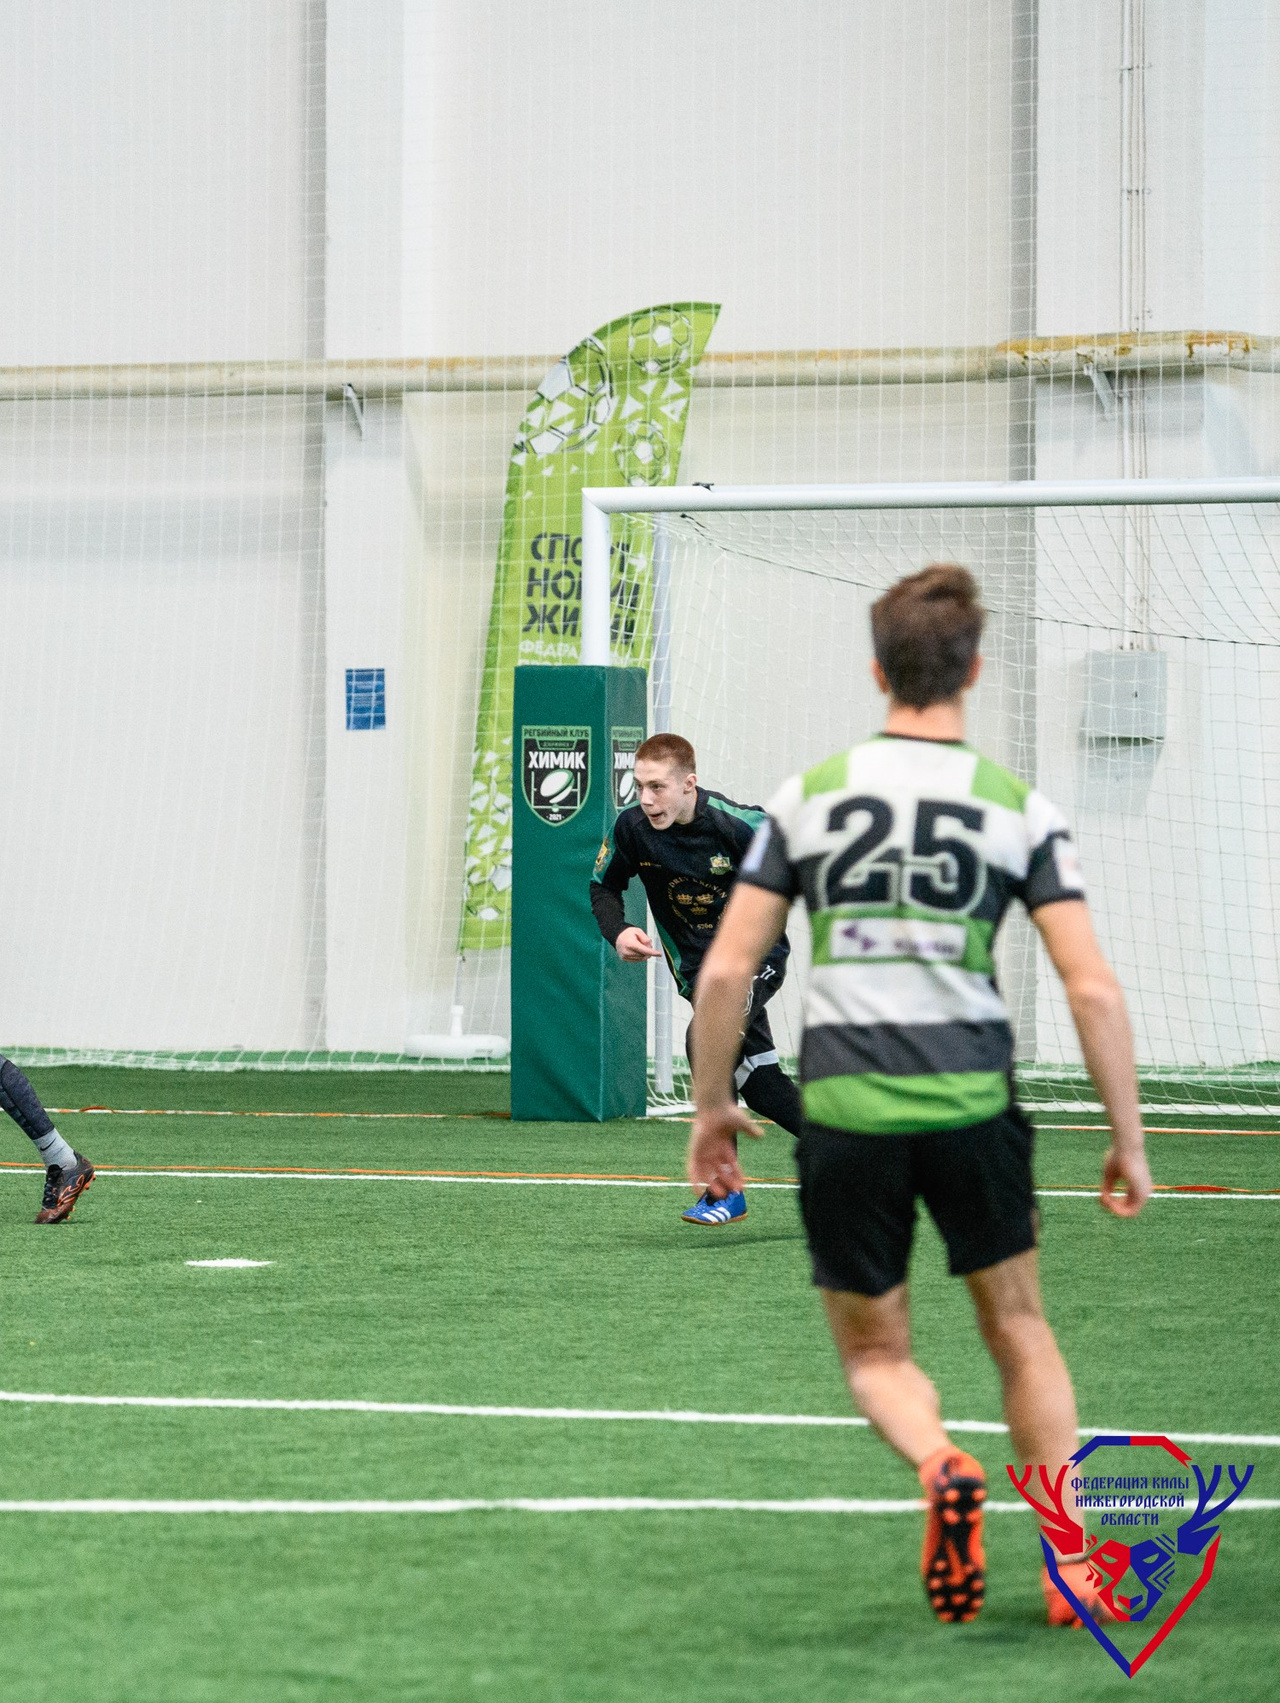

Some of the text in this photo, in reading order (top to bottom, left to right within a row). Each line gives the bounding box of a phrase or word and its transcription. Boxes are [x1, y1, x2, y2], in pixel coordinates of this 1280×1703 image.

[570, 728, 590, 738] КЛУБ
[528, 751, 586, 769] ХИМИК
[823, 794, 986, 914] 25
